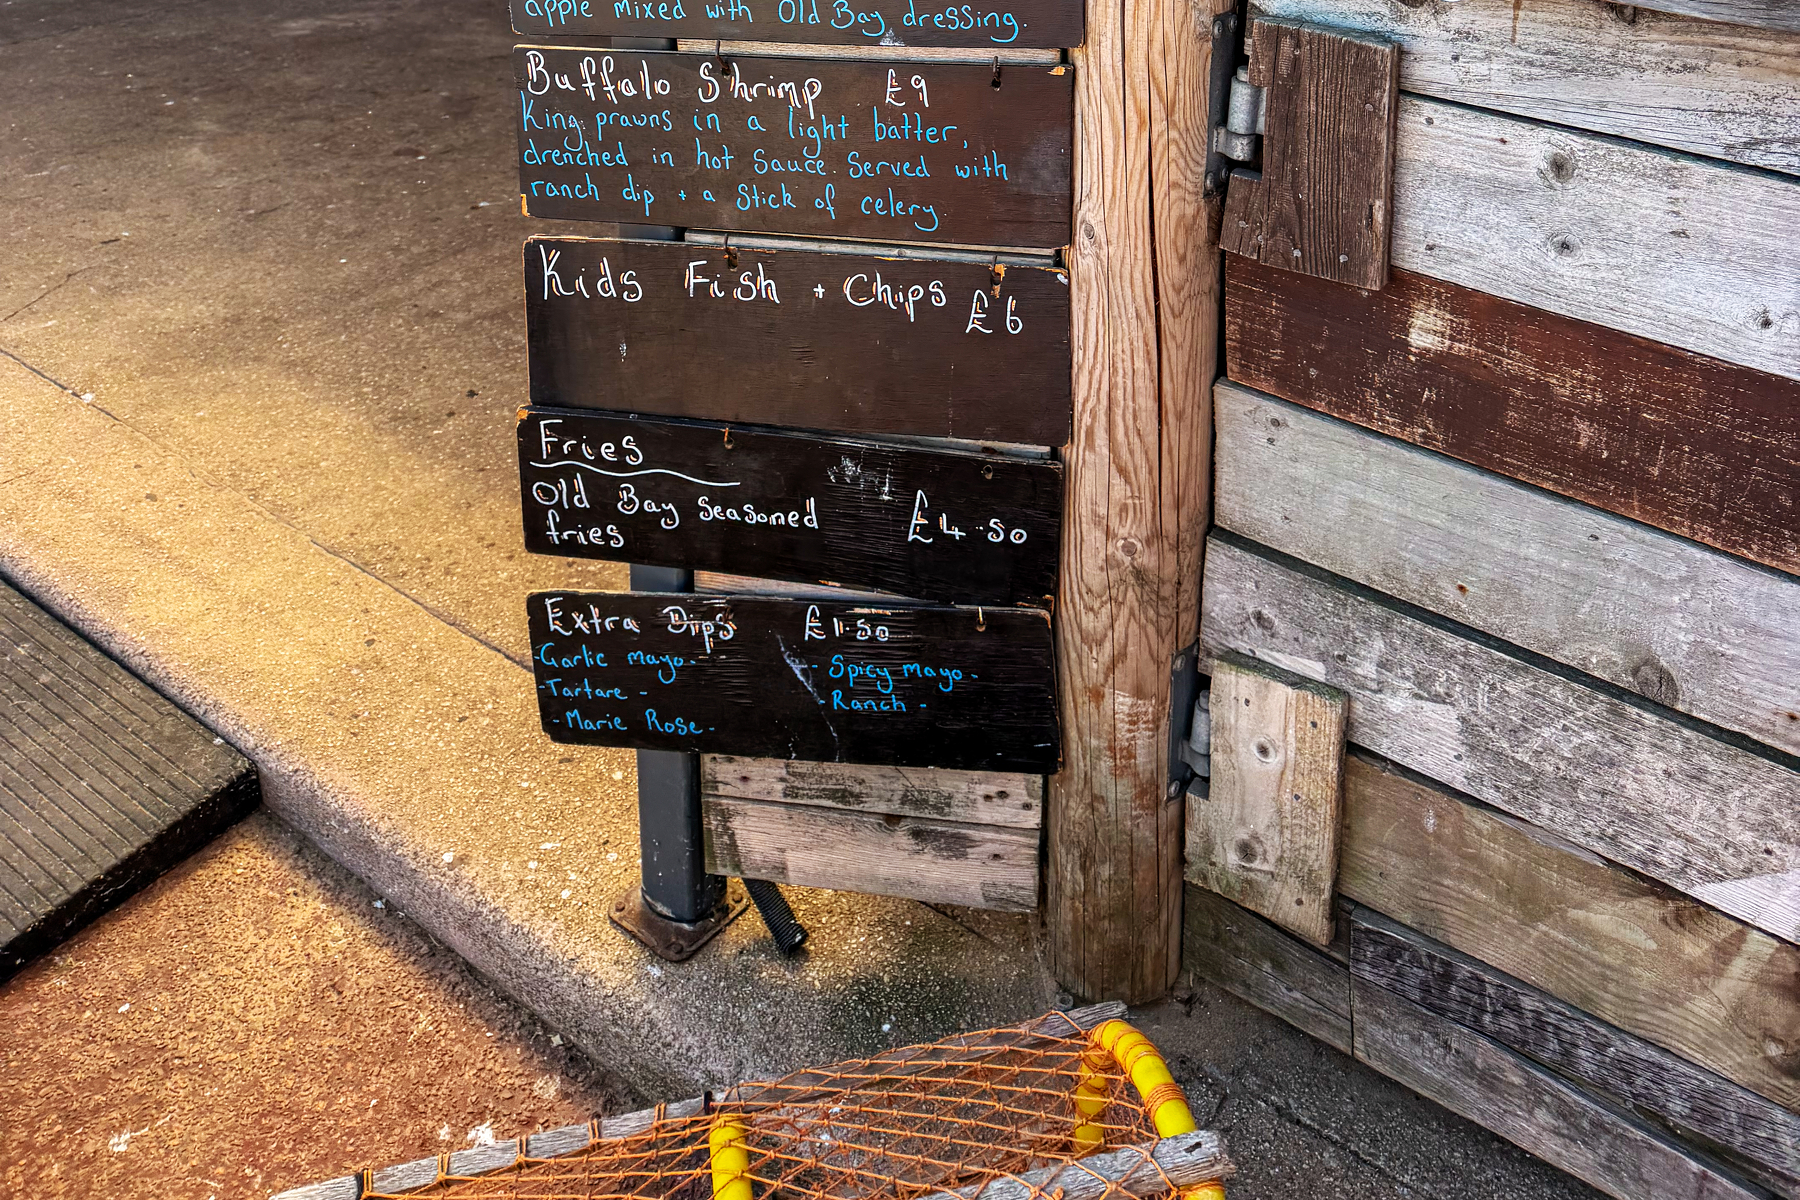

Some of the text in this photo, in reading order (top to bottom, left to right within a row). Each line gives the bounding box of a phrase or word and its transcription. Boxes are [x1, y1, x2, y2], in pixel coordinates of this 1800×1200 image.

[831, 0, 885, 36] Bay
[526, 50, 670, 104] Buffalo
[698, 62, 822, 120] Shrimp
[521, 91, 968, 158] King prawns in a light batter,
[523, 139, 628, 166] drenched
[652, 148, 674, 166] in
[696, 138, 734, 170] hot
[955, 150, 1008, 180] with
[531, 173, 600, 201] ranch
[623, 174, 654, 216] dip
[679, 190, 686, 200] +
[703, 190, 715, 202] a
[815, 184, 835, 219] of
[539, 244, 642, 302] Kids
[684, 261, 780, 304] Fish
[813, 284, 825, 299] +
[843, 270, 946, 322] Chips
[539, 419, 643, 466] Fries
[532, 473, 590, 510] Old
[617, 483, 680, 529] Bay
[546, 509, 624, 548] fries
[545, 598, 889, 653] Extra Dips £1.50
